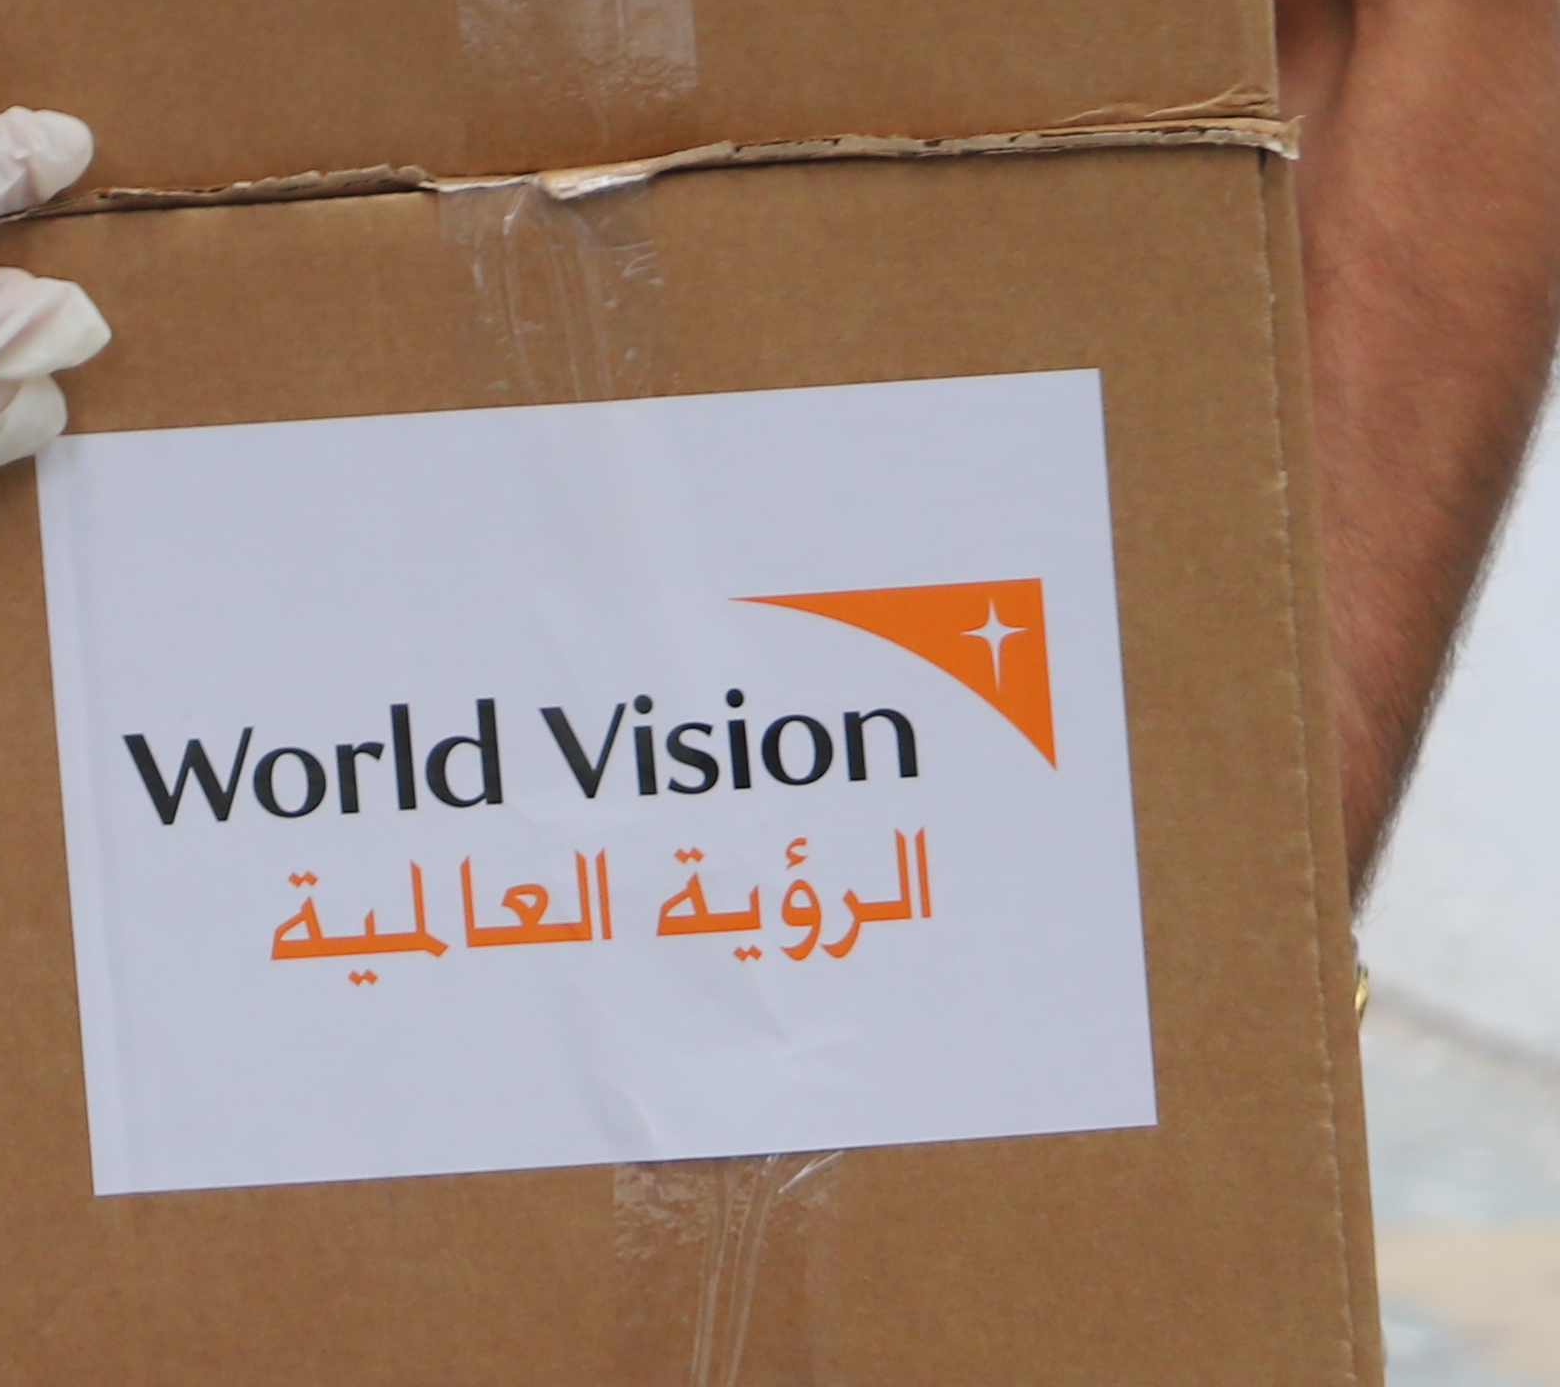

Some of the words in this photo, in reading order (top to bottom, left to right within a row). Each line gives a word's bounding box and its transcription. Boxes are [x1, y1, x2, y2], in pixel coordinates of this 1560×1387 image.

[123, 698, 504, 826] World
[540, 688, 920, 799] Vision
[270, 848, 614, 986] العالمية
[656, 828, 933, 962] الرؤية
